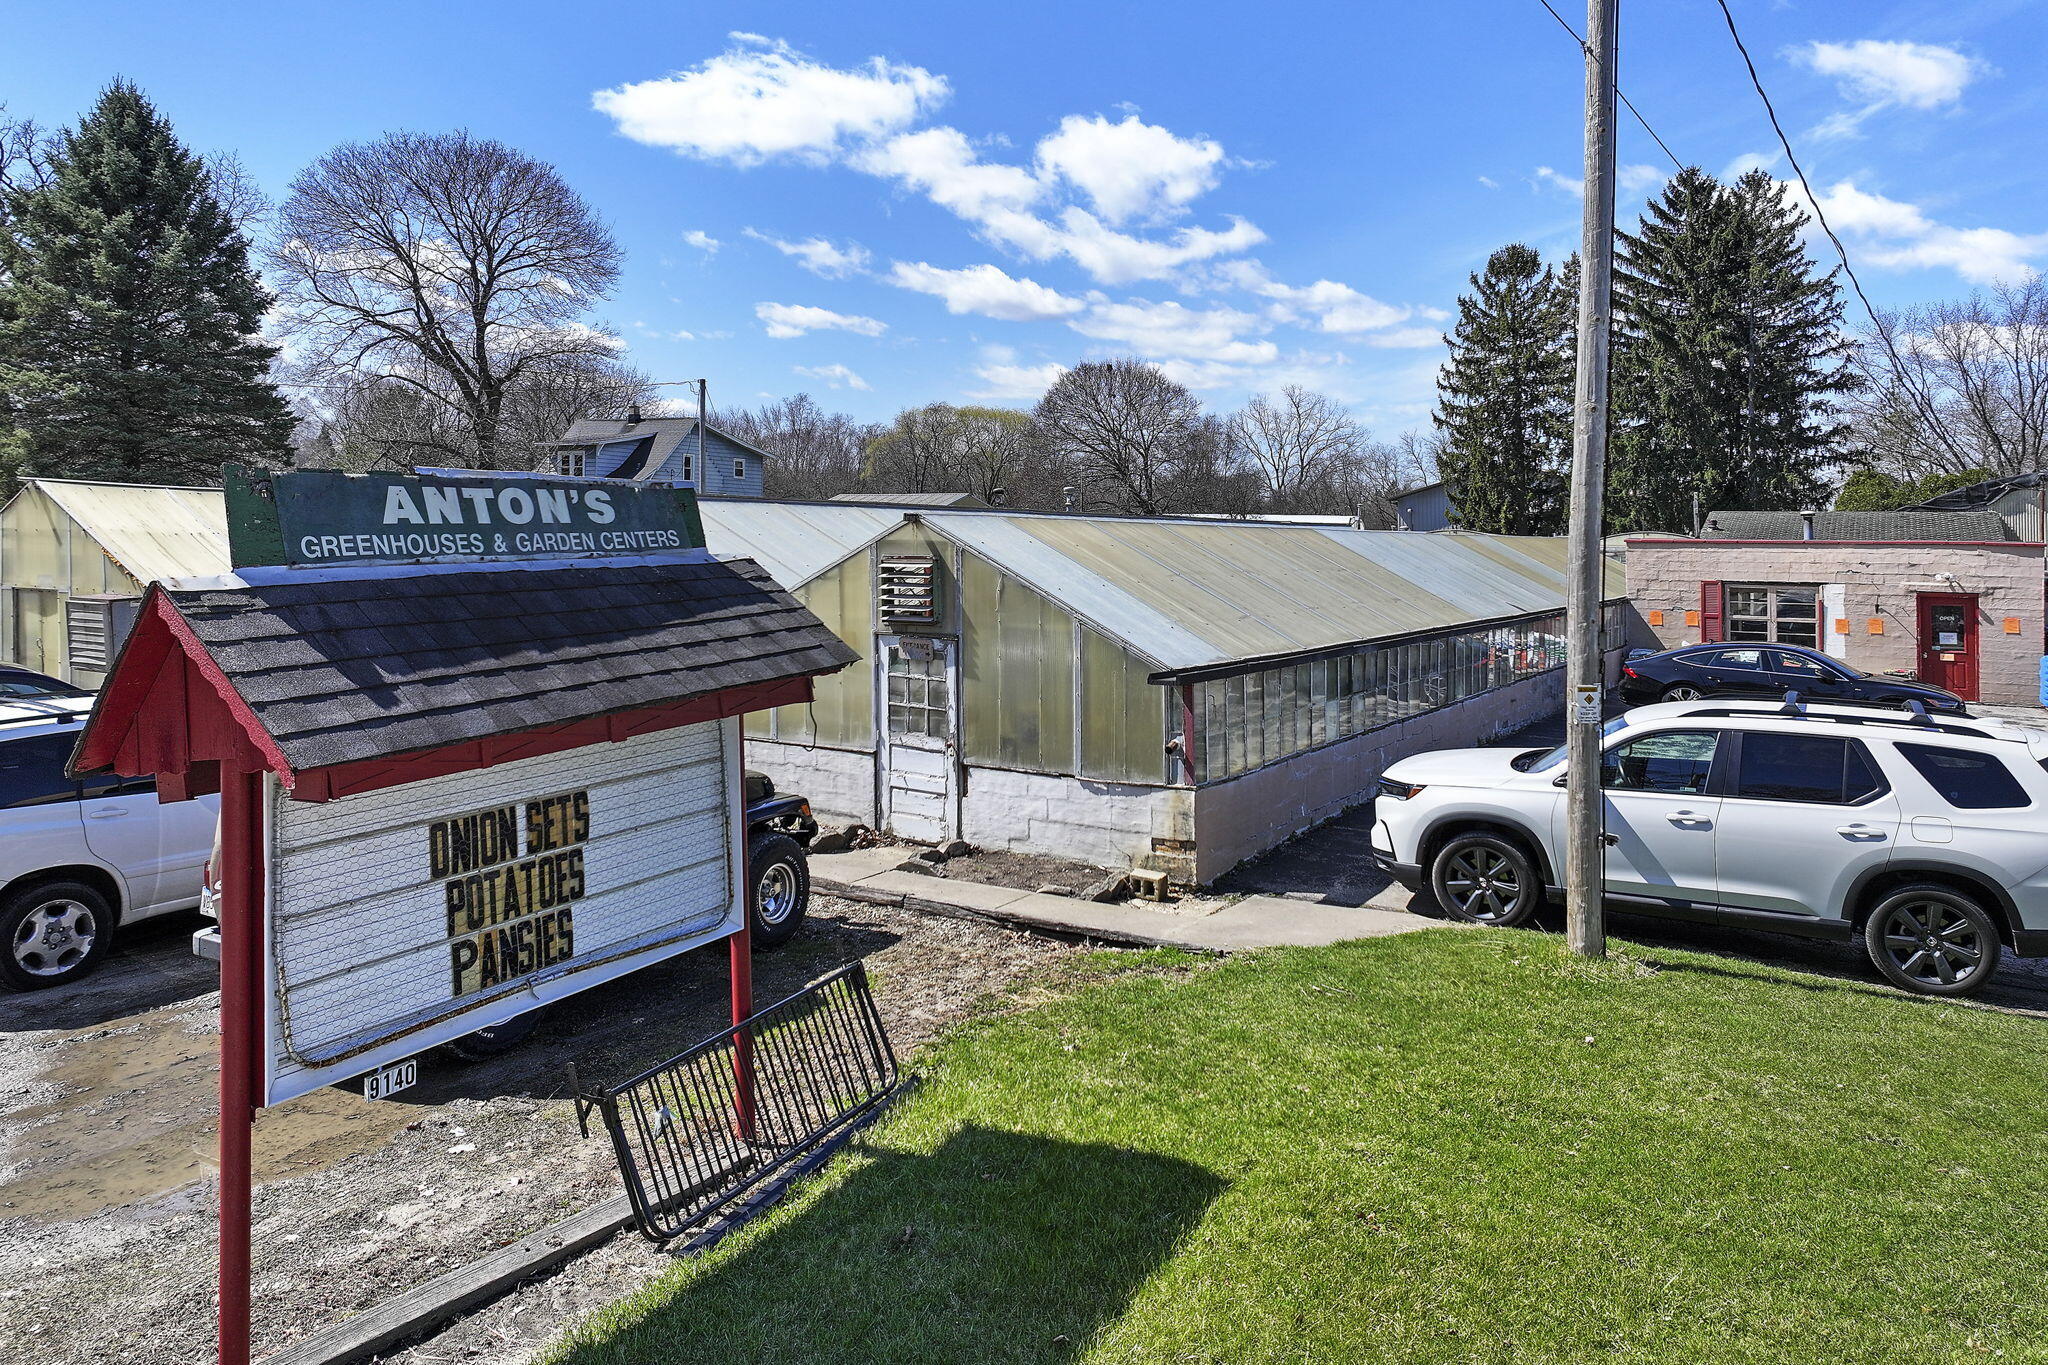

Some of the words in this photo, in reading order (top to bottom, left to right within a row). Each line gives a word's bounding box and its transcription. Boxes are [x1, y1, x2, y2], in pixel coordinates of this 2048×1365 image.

[383, 485, 616, 525] ANTON'S
[300, 532, 484, 560] GREENHOUSES
[494, 533, 508, 553] &
[515, 531, 596, 553] GARDEN
[600, 529, 680, 551] CENTERS
[430, 806, 518, 879] ONION
[526, 790, 590, 853] SETS
[446, 849, 585, 937] POTATOES
[451, 907, 574, 996] PANSIES
[370, 1063, 415, 1100] 9140
